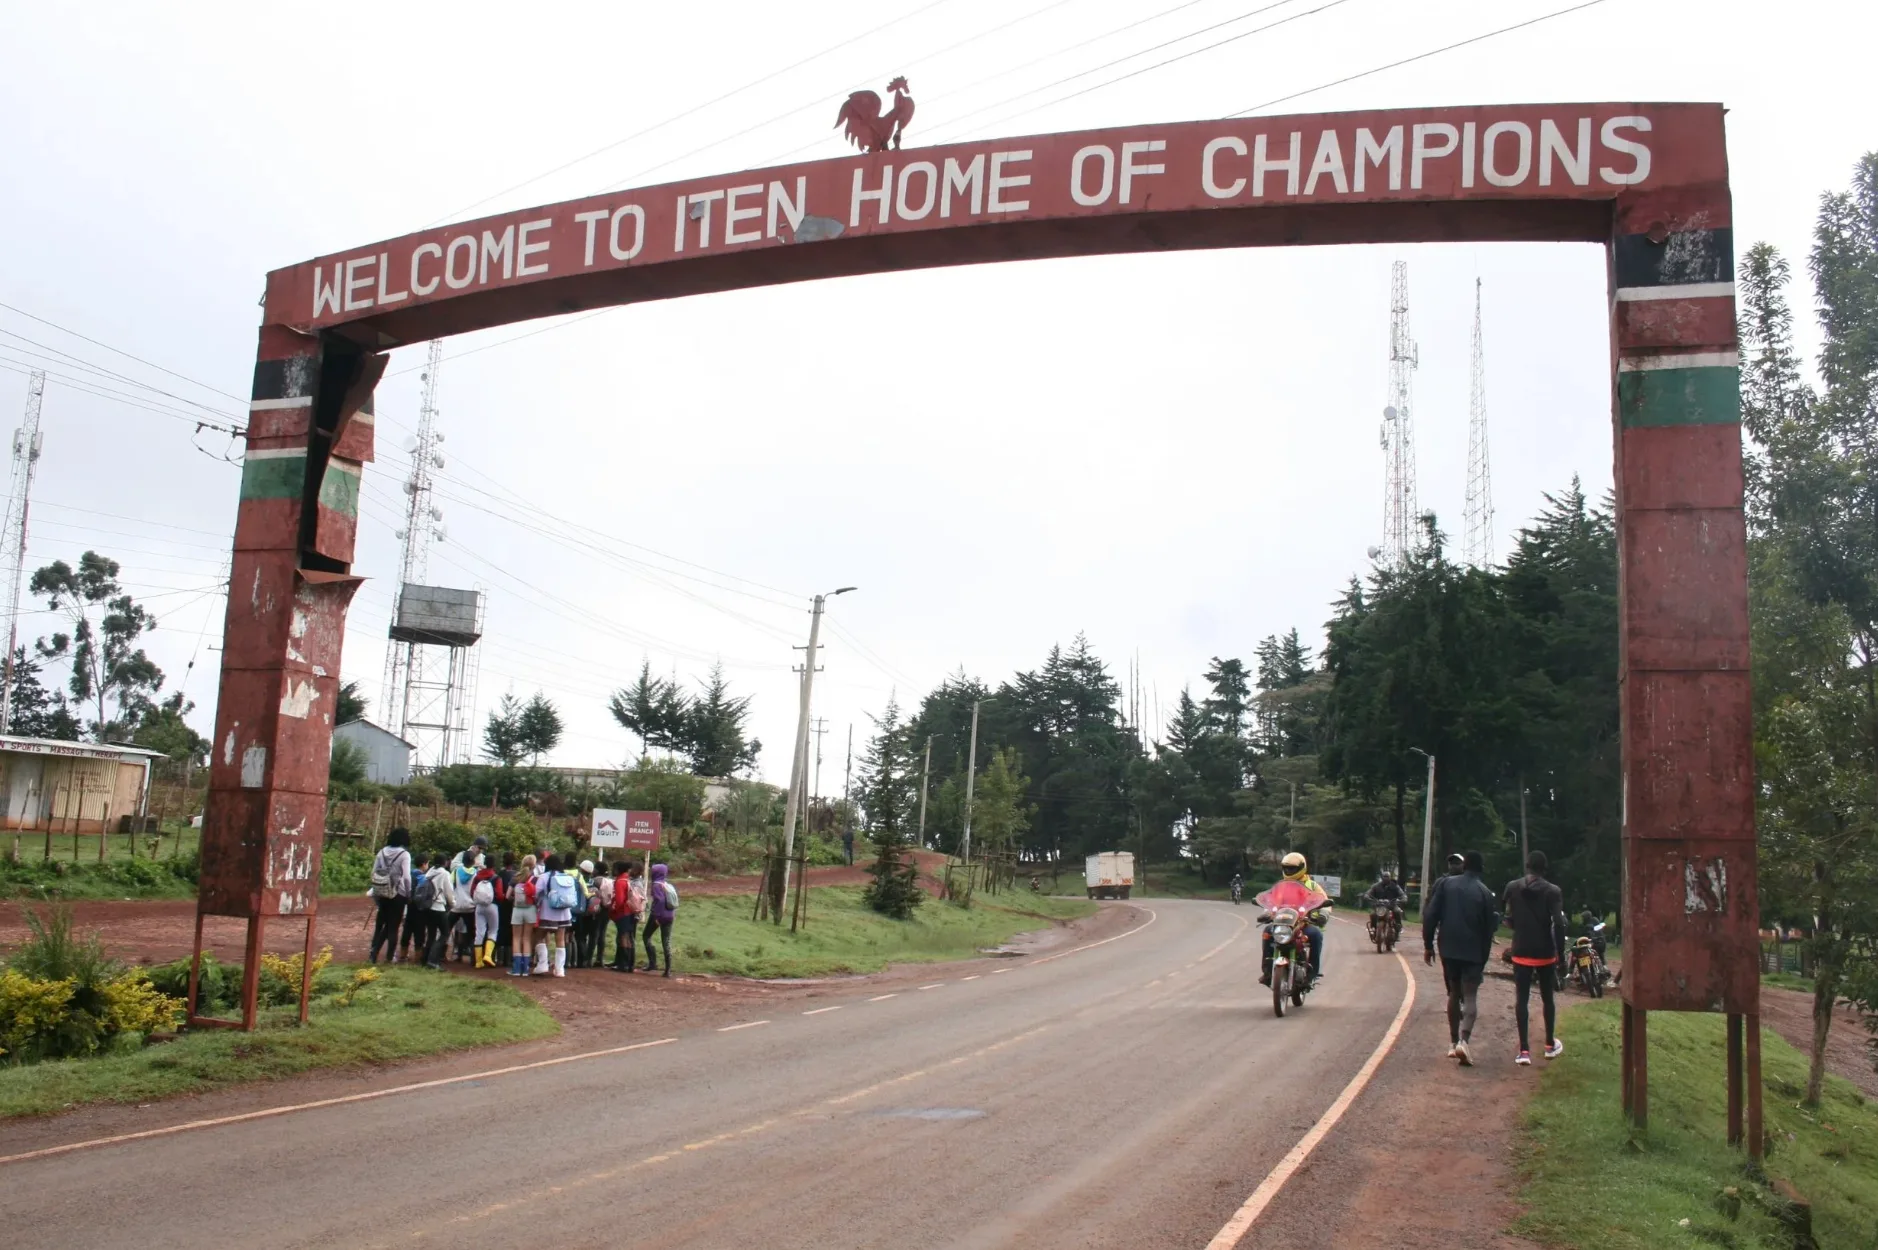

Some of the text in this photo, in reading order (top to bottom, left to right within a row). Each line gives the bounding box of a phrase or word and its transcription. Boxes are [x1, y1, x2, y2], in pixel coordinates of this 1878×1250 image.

[312, 115, 1652, 318] WELCOME TO ITEN HOME OF CHAMPIONS
[11, 741, 41, 752] SPORTS
[50, 745, 84, 756] MASSAGE
[90, 750, 124, 759] THERAPY
[634, 820, 649, 828] ITEN
[596, 829, 620, 837] EQUITY
[629, 827, 654, 835] BRANCH
